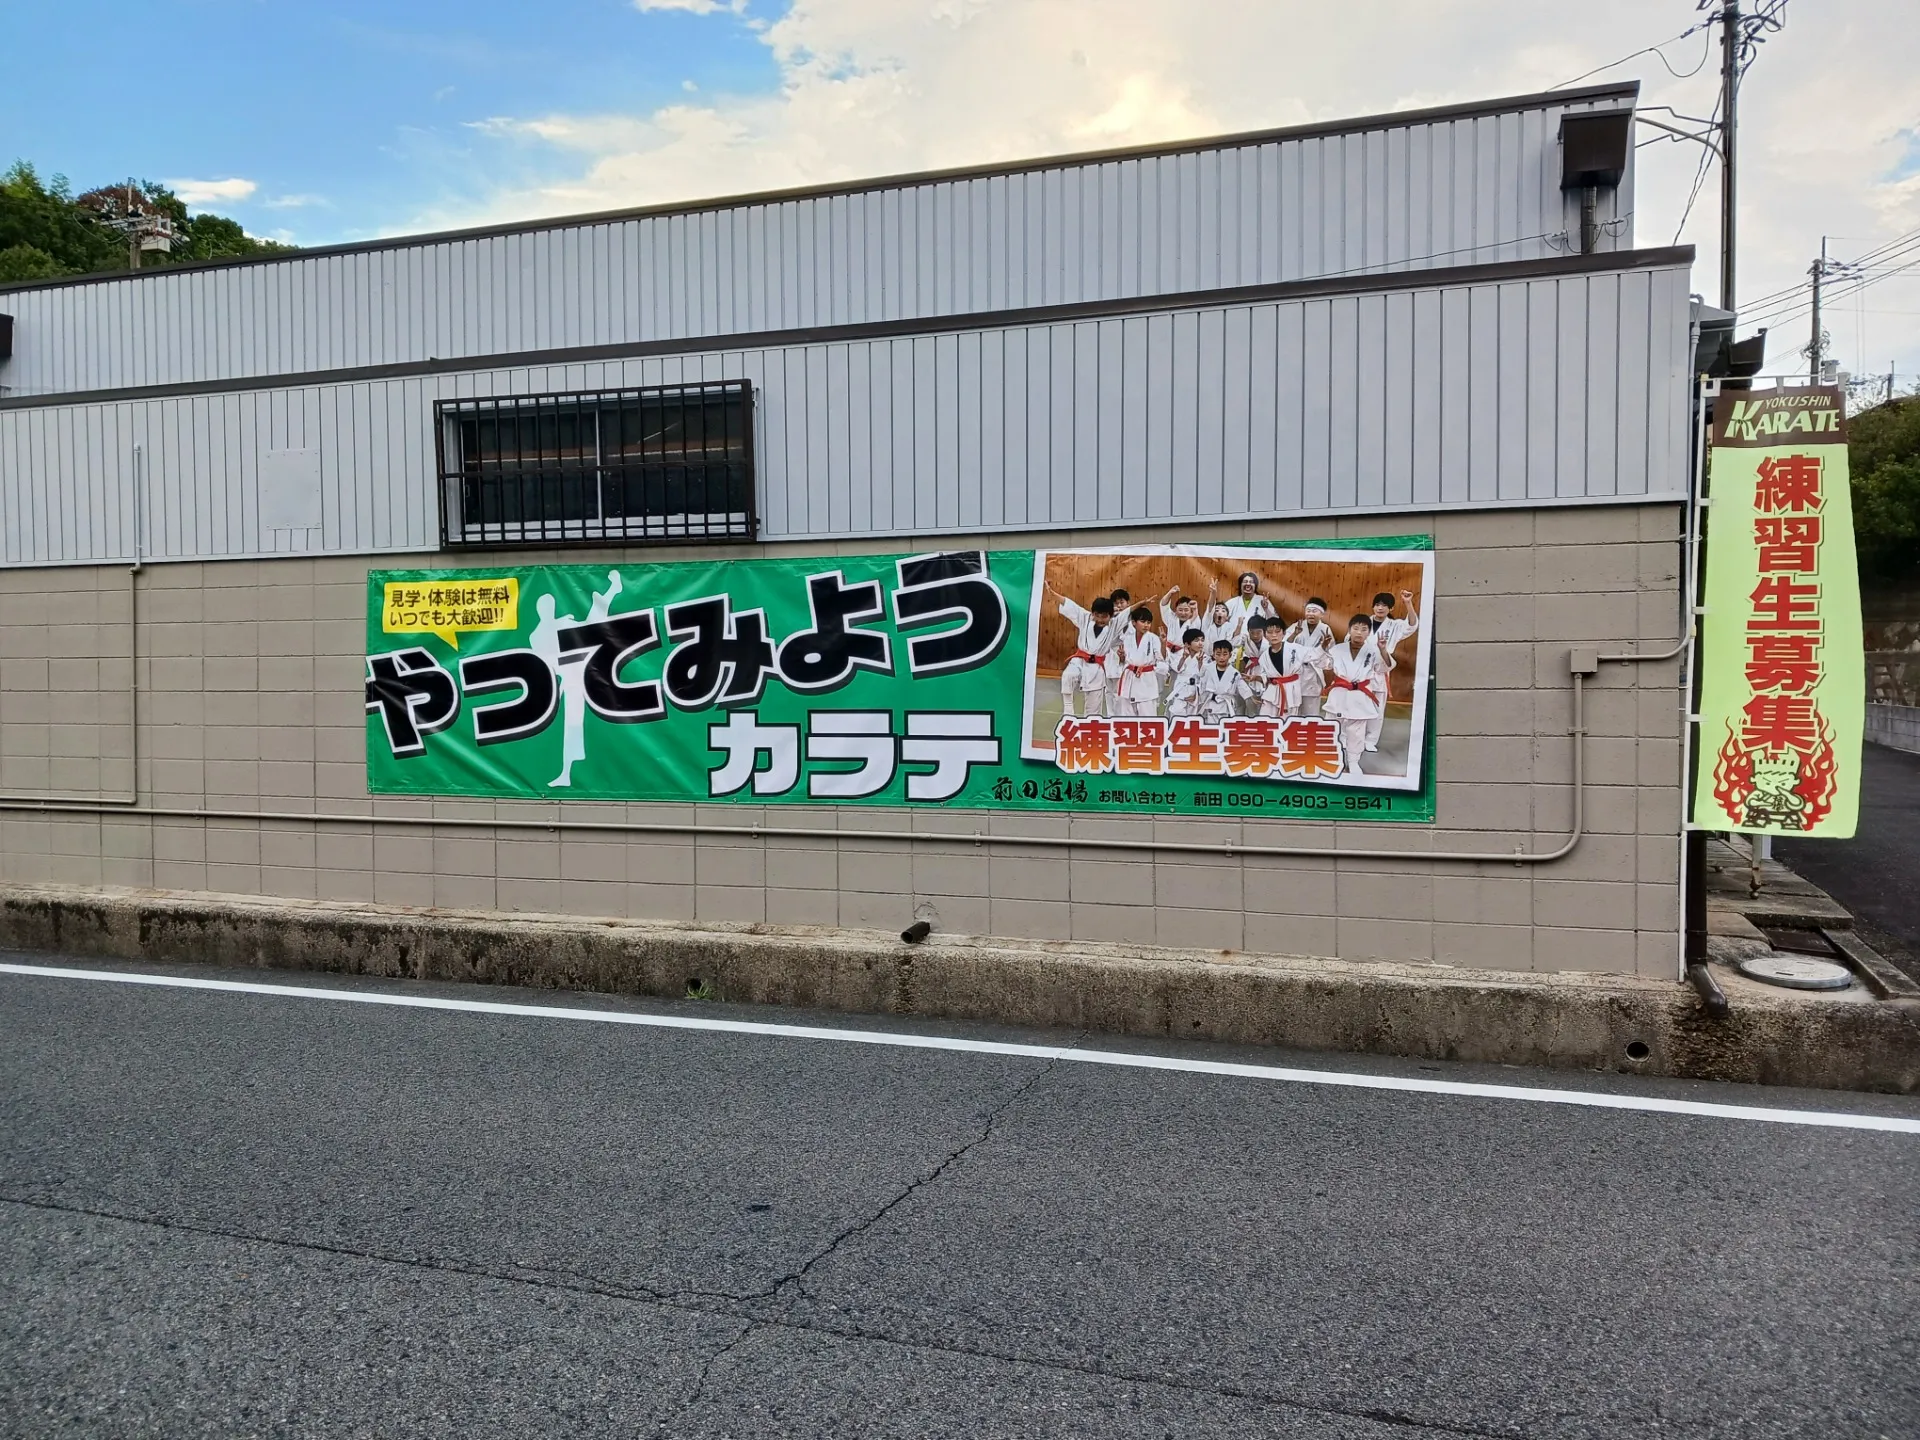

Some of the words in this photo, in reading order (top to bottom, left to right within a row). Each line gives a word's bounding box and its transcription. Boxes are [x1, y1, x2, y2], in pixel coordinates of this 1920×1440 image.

[1723, 399, 1840, 441] KARATE
[391, 586, 510, 607] 見学・体験は無料
[1742, 454, 1823, 752] 練習生募集
[366, 550, 1009, 759] やってみよう
[707, 708, 1002, 801] カラテ
[1057, 718, 1345, 778] 練習生募集
[1194, 792, 1223, 807] 前田
